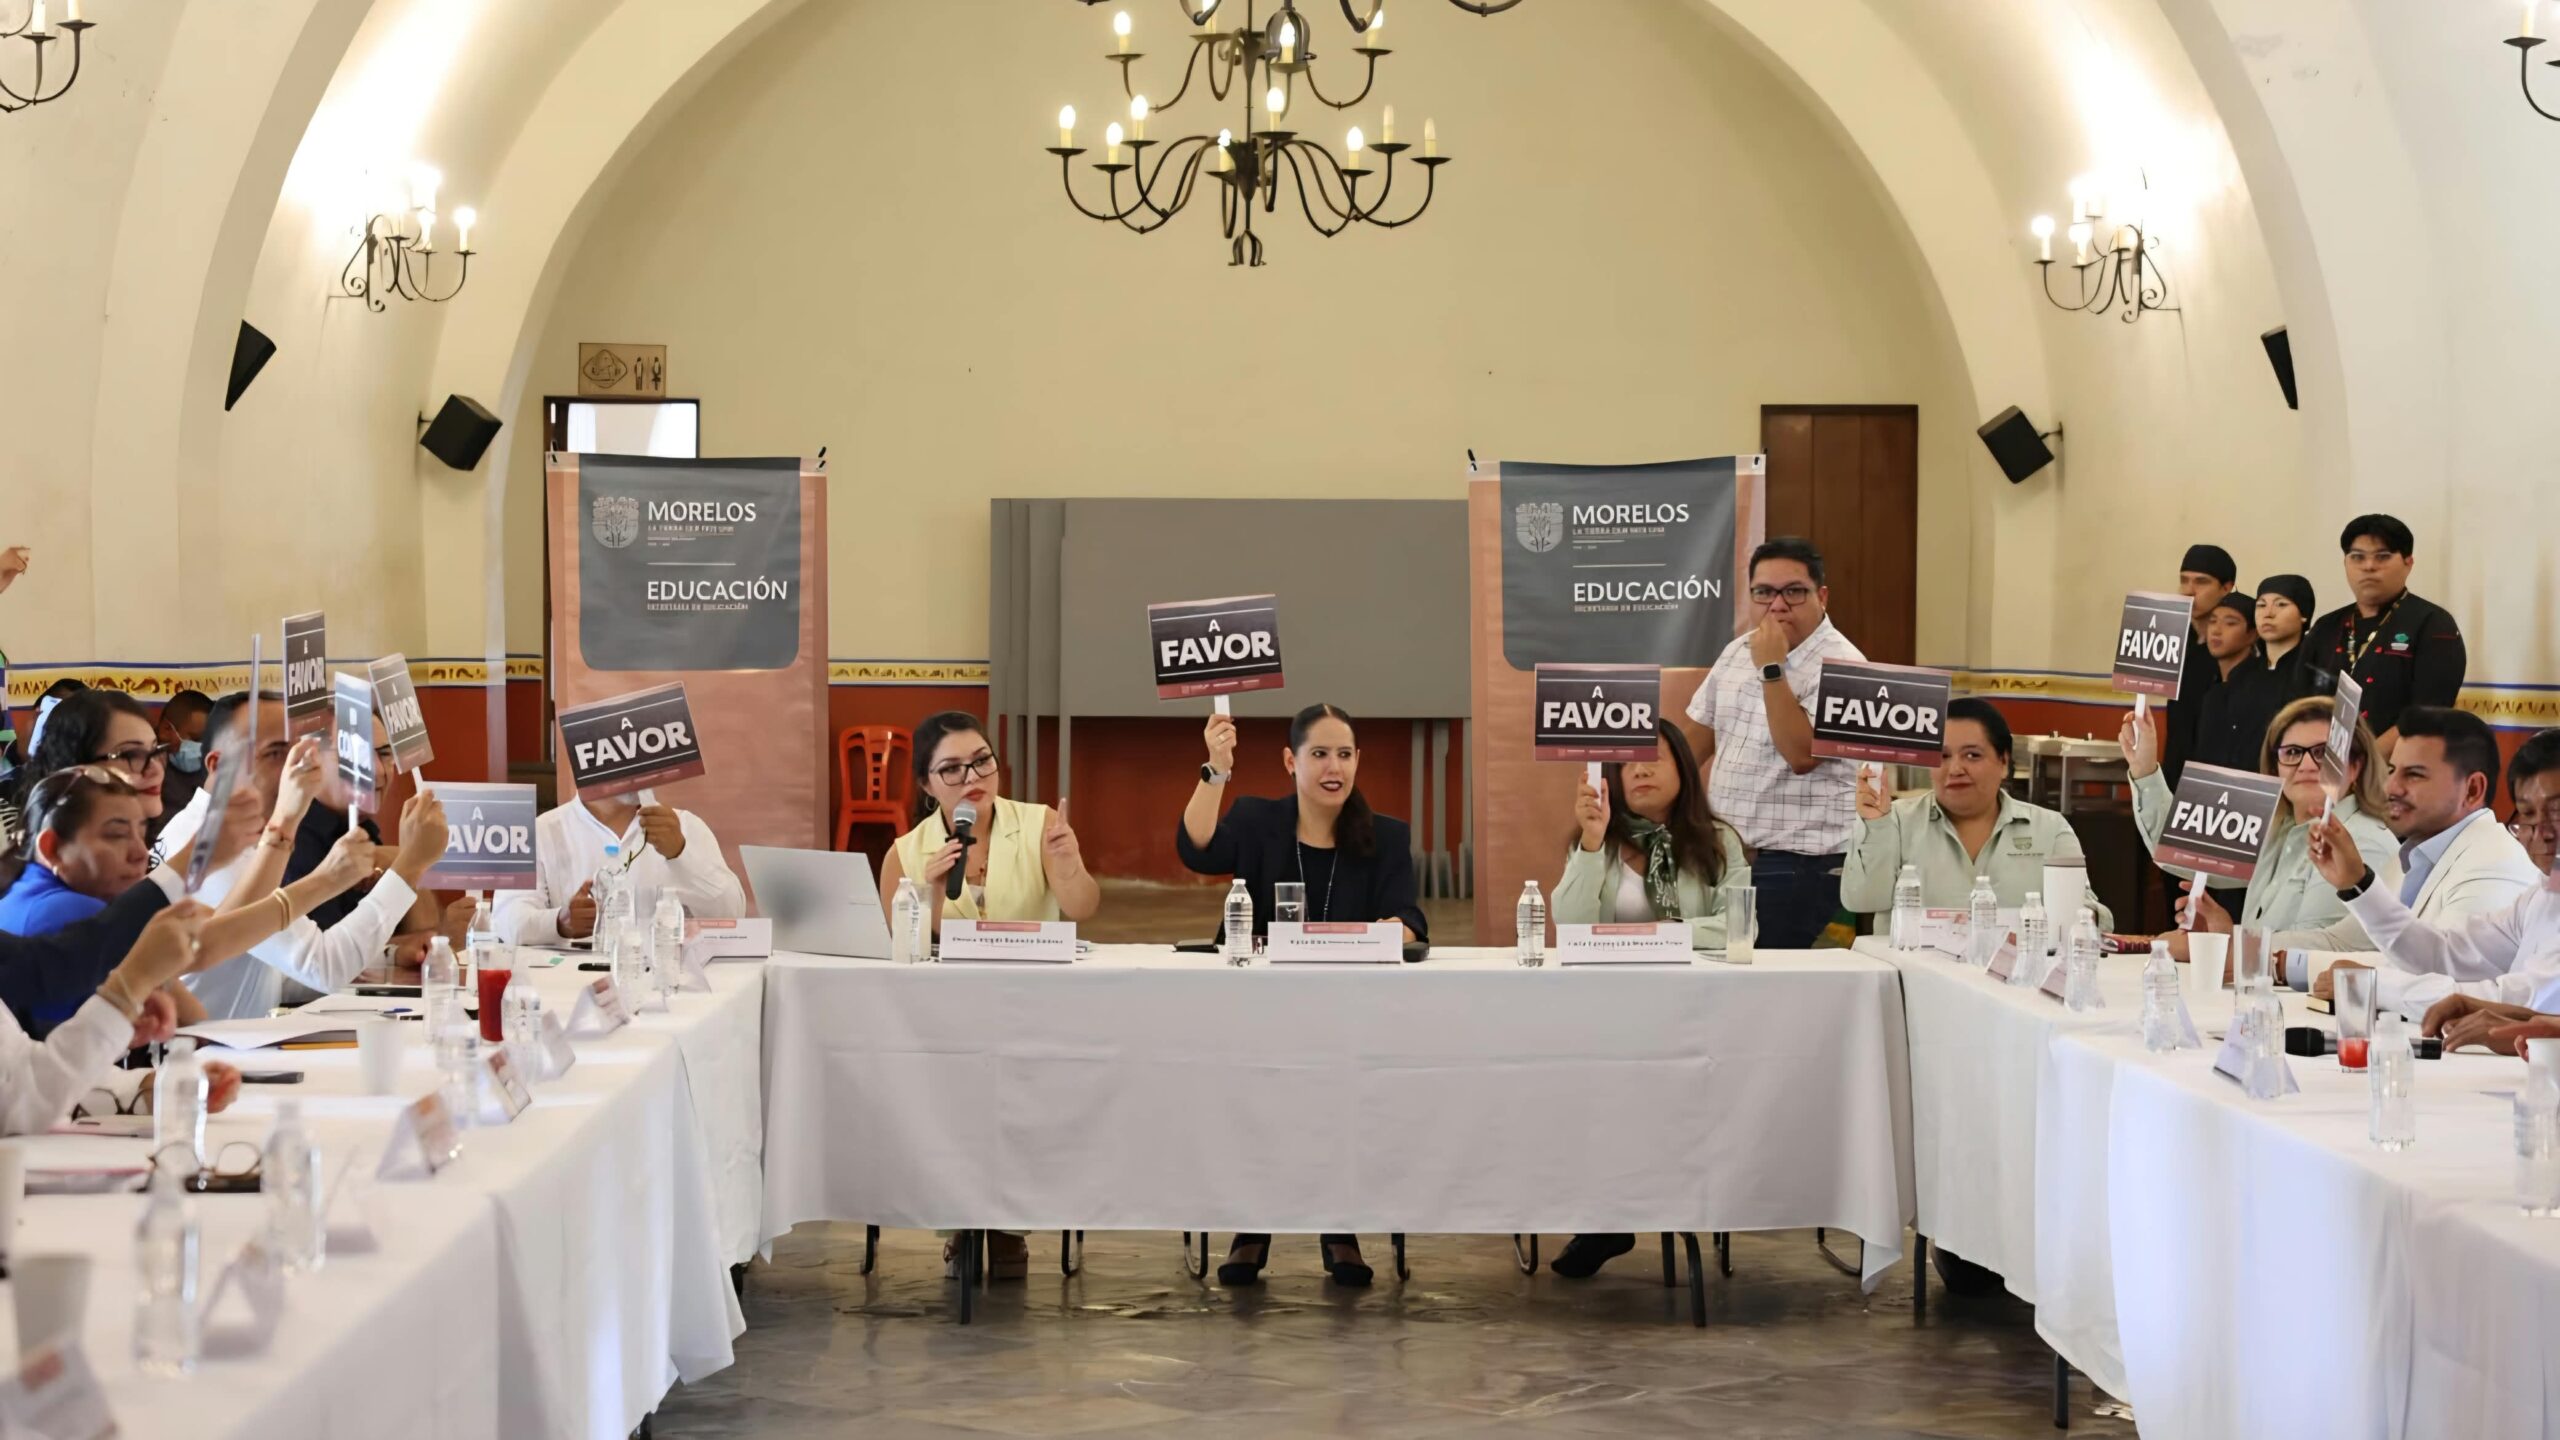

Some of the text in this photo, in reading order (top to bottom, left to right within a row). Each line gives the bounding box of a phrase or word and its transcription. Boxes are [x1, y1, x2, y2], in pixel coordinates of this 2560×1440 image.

[648, 501, 756, 522] MORELOS
[1573, 503, 1689, 525] MORELOS
[647, 576, 787, 600] EDUCACIÓN
[1574, 575, 1721, 602] EDUCACIÓN
[1208, 619, 1221, 632] A
[2148, 614, 2156, 629] A
[1160, 631, 1275, 668] FAVOR
[2120, 628, 2181, 664] FAVOR
[1591, 685, 1604, 699] A
[1877, 685, 1889, 699] A
[621, 717, 633, 730] A
[1543, 701, 1653, 730] FAVOR
[1824, 696, 1939, 735] FAVOR
[574, 721, 692, 770] FAVOR
[2217, 791, 2229, 806] A
[471, 806, 484, 821] A
[2171, 800, 2262, 846] FAVOR
[445, 824, 531, 854] AVOR
